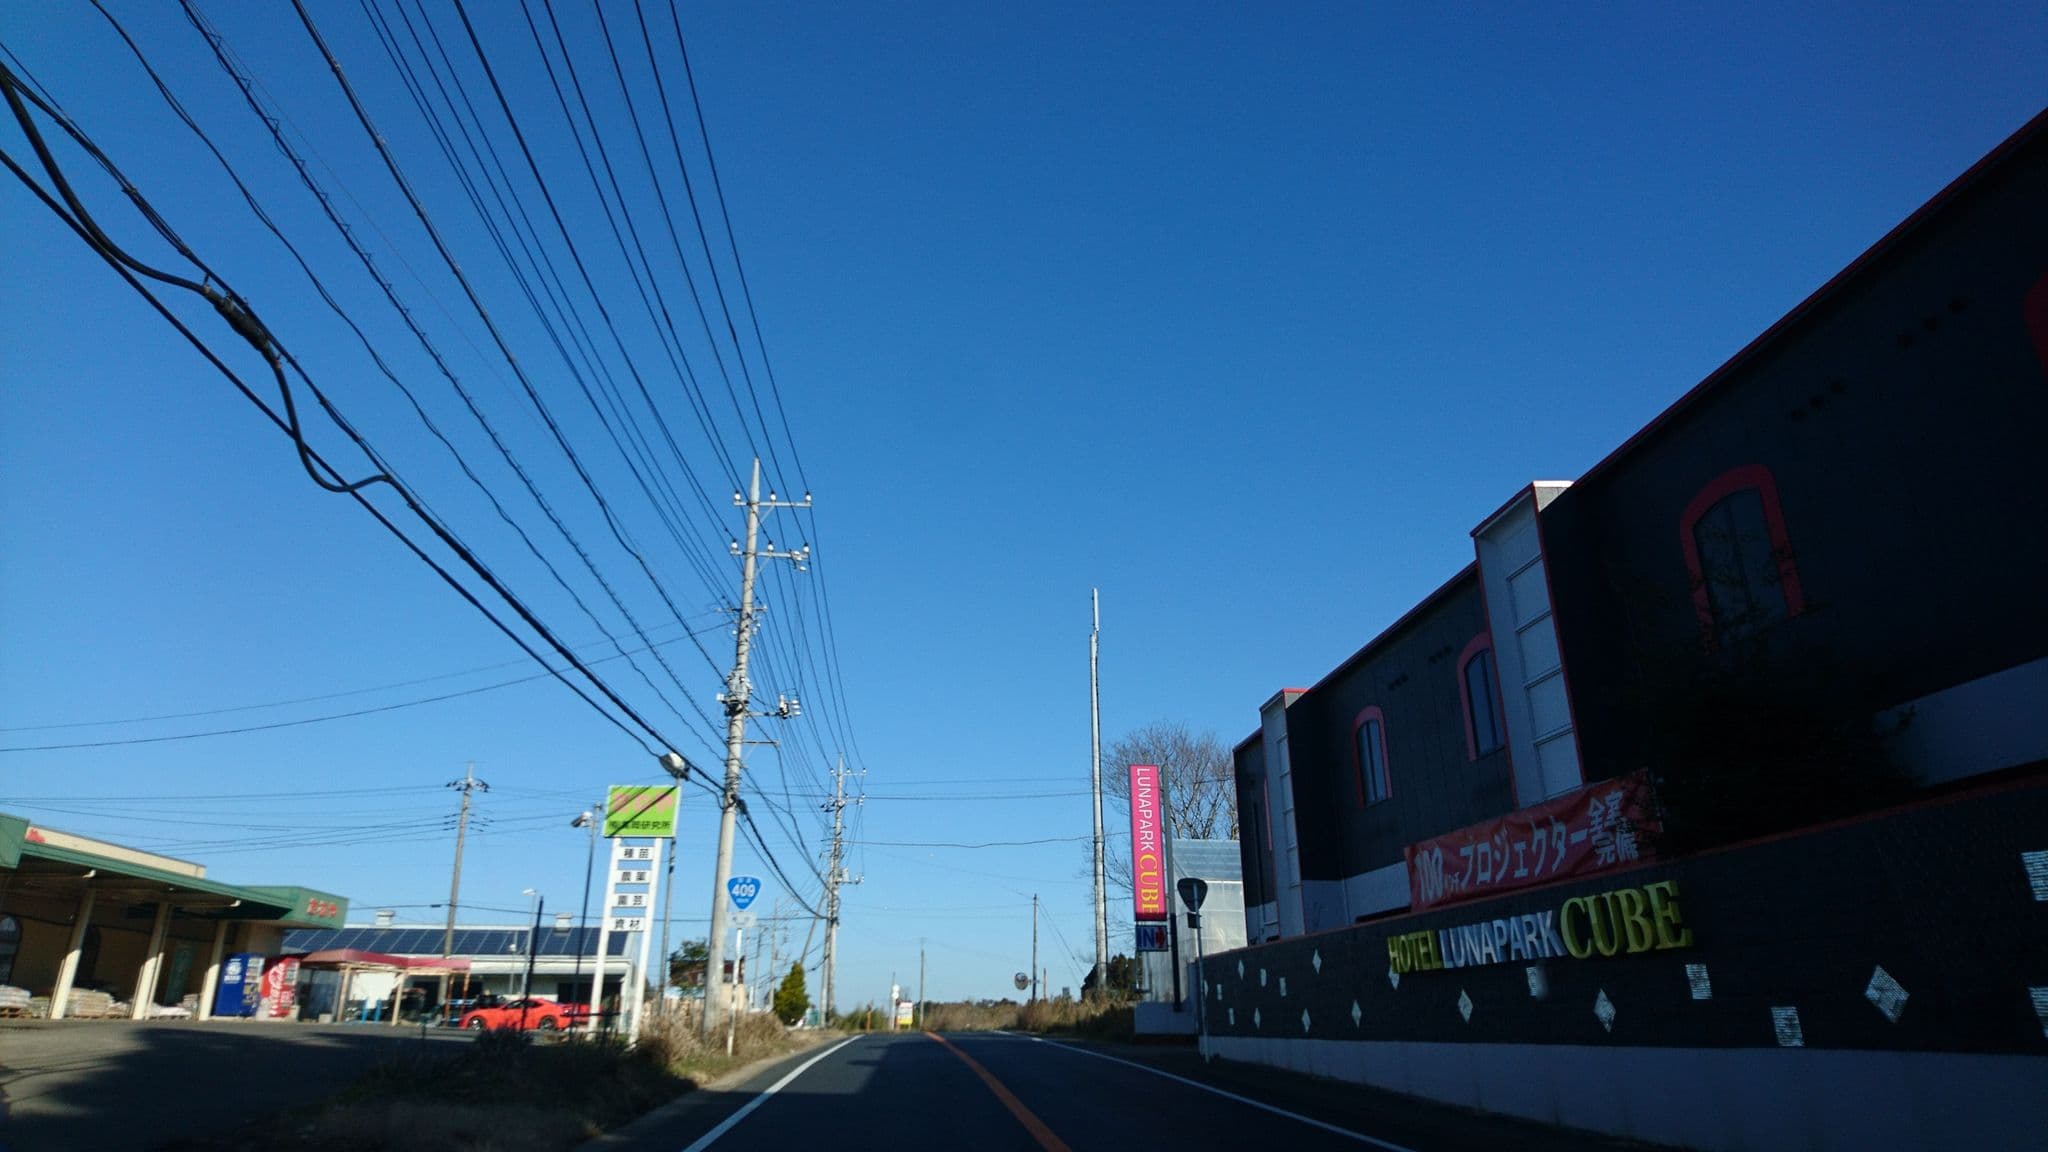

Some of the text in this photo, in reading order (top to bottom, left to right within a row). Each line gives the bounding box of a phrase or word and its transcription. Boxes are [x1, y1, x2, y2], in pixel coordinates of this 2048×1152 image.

[1136, 768, 1159, 916] LUNAPARK CUBE
[731, 884, 756, 897] 409
[1387, 880, 1693, 974] HOTEL LUNAPARK CUBE
